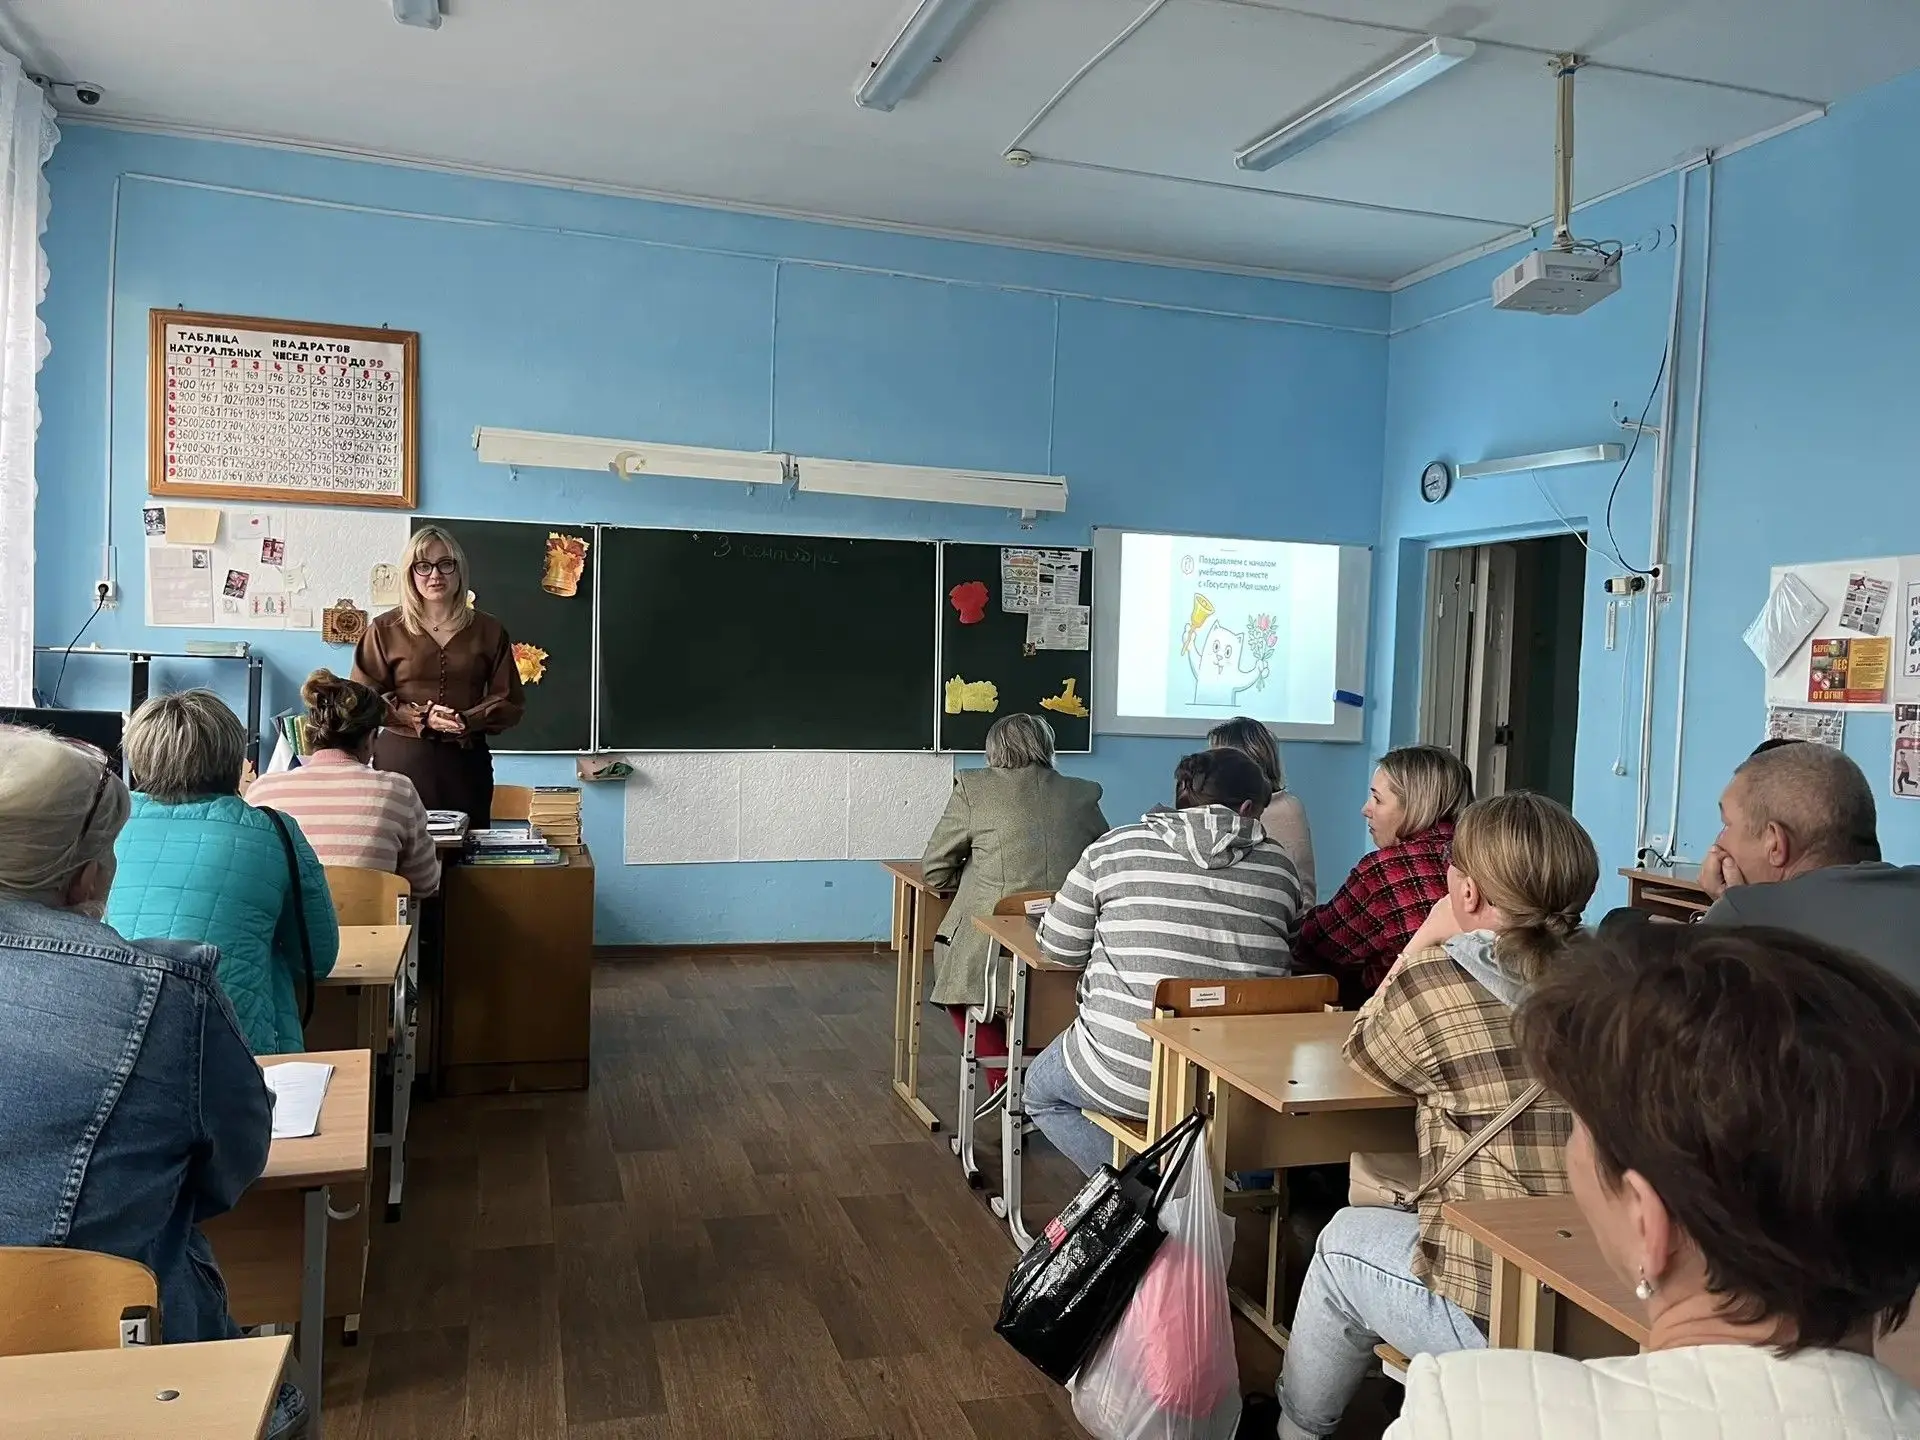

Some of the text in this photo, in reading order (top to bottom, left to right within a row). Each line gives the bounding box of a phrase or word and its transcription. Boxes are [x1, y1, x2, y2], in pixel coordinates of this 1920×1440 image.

[178, 331, 351, 353] ТАБЛИЦА КВАДРАТОВ
[208, 357, 214, 367] 1
[231, 360, 238, 368] 2
[253, 361, 259, 369] 3
[274, 362, 282, 371] 4
[297, 365, 304, 373] 5
[319, 366, 326, 375] 6
[340, 368, 347, 377] 7
[363, 370, 370, 379] 8
[383, 372, 391, 380] 9
[272, 351, 308, 362] ЧИСЕЛ
[315, 355, 332, 364] ОТ
[334, 356, 347, 364] 10
[349, 358, 366, 368] ДО
[369, 359, 384, 368] 99
[168, 366, 175, 375] 1
[177, 367, 191, 376] 100
[201, 369, 216, 377] 121
[246, 371, 258, 379] 169
[269, 373, 283, 382] 196
[289, 375, 306, 384] 225
[311, 376, 327, 386] 256
[333, 378, 351, 387] 289
[356, 379, 373, 389] 324
[377, 381, 394, 391] 361
[169, 379, 393, 403] 2 400 441 484 529 576 625 676 729 784 841
[169, 392, 176, 400] 3
[179, 392, 195, 401] 900
[201, 394, 218, 403] 961
[223, 395, 244, 405] 1024
[245, 397, 265, 406] 1089
[268, 398, 285, 408] 1156
[291, 400, 309, 409] 1225
[312, 401, 330, 410] 1296
[334, 403, 352, 412] 1369
[378, 406, 397, 416] 1521
[169, 405, 176, 413] 4
[177, 405, 197, 414] 1600
[223, 408, 243, 418] 1764
[246, 410, 265, 419] 1849
[289, 412, 309, 422] 2025
[312, 413, 330, 423] 2116
[334, 415, 355, 425] 2209
[377, 419, 396, 429] 2401
[168, 417, 175, 425] 5
[178, 418, 198, 427] 2500
[200, 419, 220, 429] 2601
[290, 425, 310, 434] 3025
[312, 427, 331, 436] 3136
[335, 428, 354, 438] 3249
[355, 429, 375, 440] 3364
[377, 432, 397, 441] 3481
[168, 430, 175, 438] 6
[177, 429, 198, 440] 3600
[200, 430, 221, 441] 3721
[223, 432, 242, 442] 3844
[246, 434, 265, 444] 3969
[291, 437, 310, 448] 4225
[311, 438, 332, 449] 4356
[355, 441, 373, 452] 4624
[377, 444, 397, 453] 4761
[169, 443, 175, 451] 7
[177, 443, 198, 452] 4900
[200, 445, 220, 454] 5041
[223, 446, 243, 455] 5184
[245, 448, 265, 457] 5329
[311, 452, 331, 461] 5776
[335, 453, 354, 463] 5929
[355, 455, 374, 464] 6084
[377, 456, 397, 465] 6241
[169, 455, 175, 464] 8
[178, 456, 199, 465] 6400
[200, 457, 221, 466] 6561
[268, 461, 288, 471] 7056
[290, 462, 310, 471] 7225
[312, 464, 331, 474] 7396
[335, 466, 353, 475] 7569
[356, 467, 373, 477] 7744
[378, 469, 397, 478] 7921
[169, 467, 175, 476] 9
[177, 468, 197, 477] 8100
[201, 470, 221, 479] 8281
[223, 471, 242, 481] 8464
[312, 476, 331, 486] 9216
[335, 478, 354, 488] 9409
[377, 481, 396, 490] 9801
[713, 535, 731, 558] 3
[1199, 555, 1243, 566] Поздравляем
[1249, 560, 1276, 568] началом
[1198, 568, 1268, 579] учебного года вместе
[126, 1325, 141, 1345] 1
